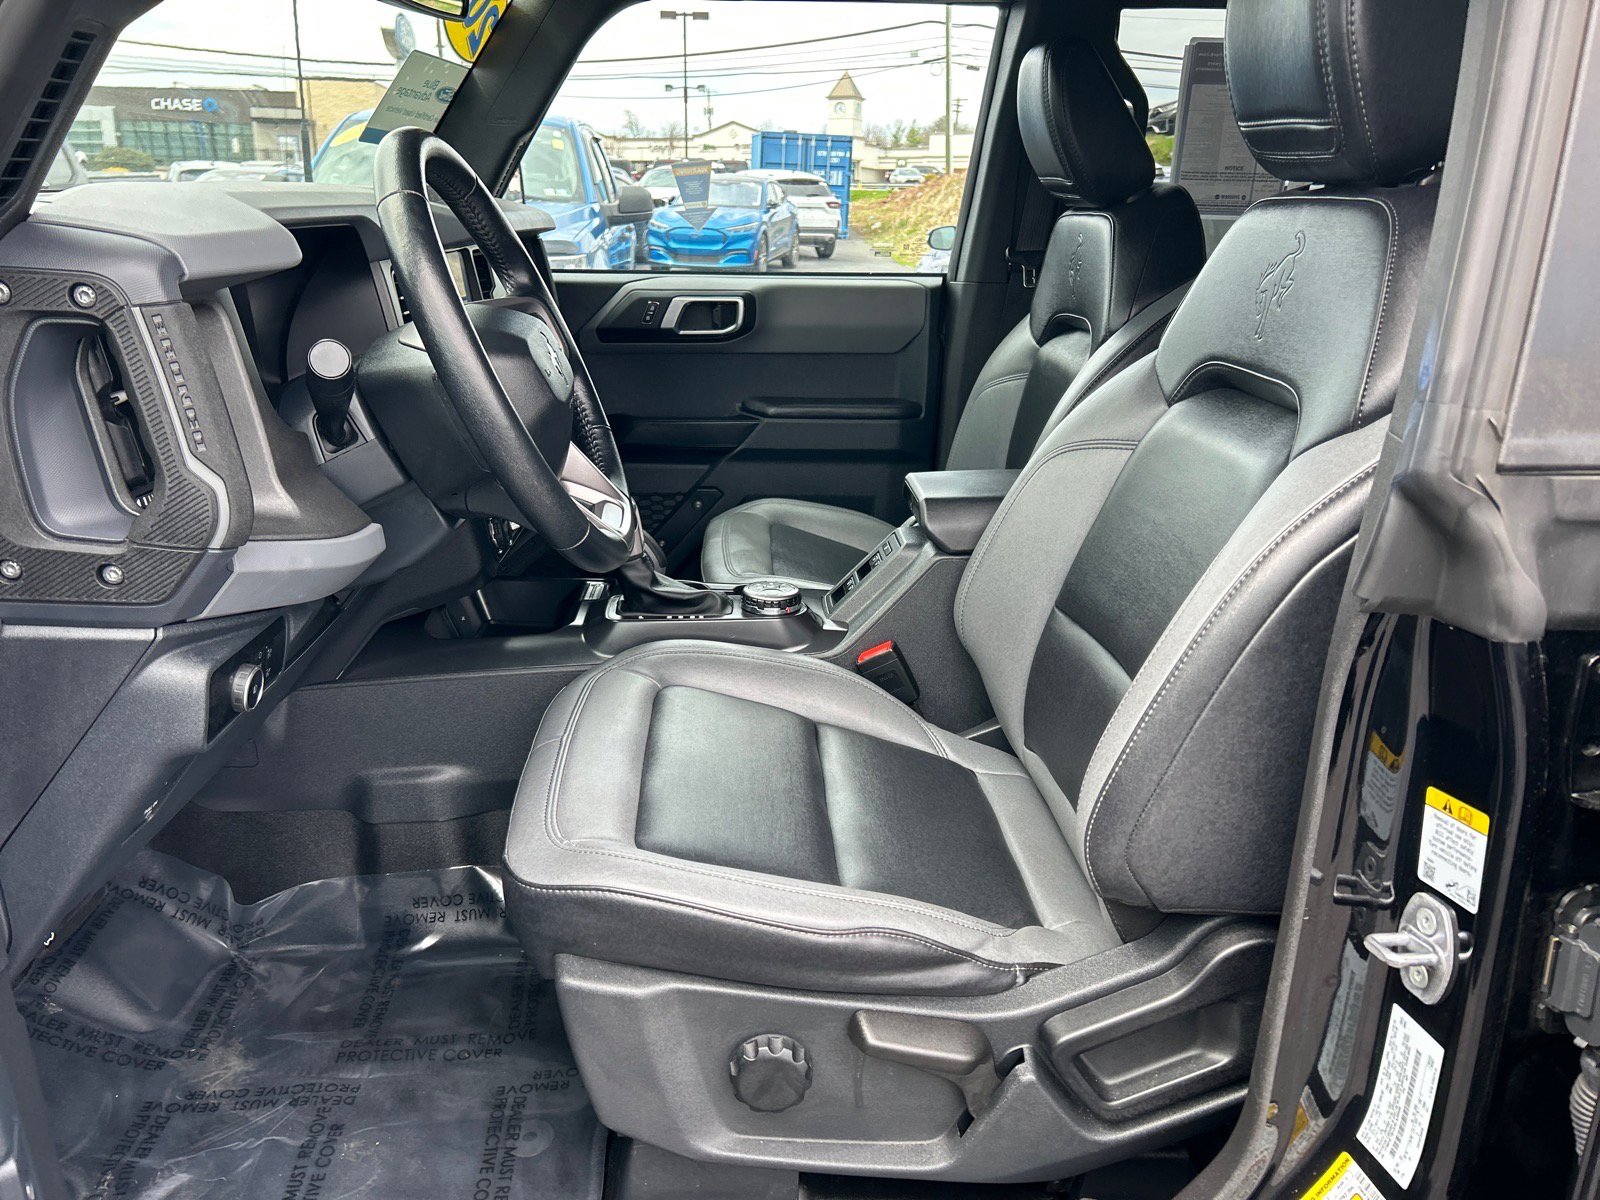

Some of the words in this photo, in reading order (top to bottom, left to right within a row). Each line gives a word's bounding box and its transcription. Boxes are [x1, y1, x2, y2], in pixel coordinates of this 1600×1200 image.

[151, 98, 202, 111] CHASE
[151, 313, 207, 451] BRONCO
[138, 875, 190, 903] COVER
[412, 893, 464, 909] COVER
[171, 910, 212, 930] MUST
[384, 911, 446, 928] REMOVE
[455, 908, 490, 922] MUST
[76, 1027, 126, 1047] MUST
[340, 1038, 404, 1049] DEALER
[414, 1034, 457, 1046] MUST
[467, 1028, 537, 1047] REMOVE
[101, 1051, 165, 1071] COVER
[335, 1049, 438, 1063] PROTECTIVE
[443, 1048, 504, 1061] COVER
[532, 1067, 580, 1081] OVER
[185, 1088, 250, 1100] COVER
[256, 1082, 361, 1097] PROTECTIVE
[496, 1080, 570, 1096] REMOVE
[140, 1101, 221, 1114] REMOVE
[229, 1099, 278, 1112] MUST
[288, 1095, 358, 1107] DEALER
[504, 1096, 528, 1142] DEALER
[130, 1115, 171, 1159] DEALER
[297, 1105, 332, 1160] REMOVE
[480, 1098, 508, 1174] PROTECTIVE
[315, 1123, 346, 1168] COVER
[498, 1147, 518, 1181] MUST
[1315, 1157, 1351, 1199] INFORMATION
